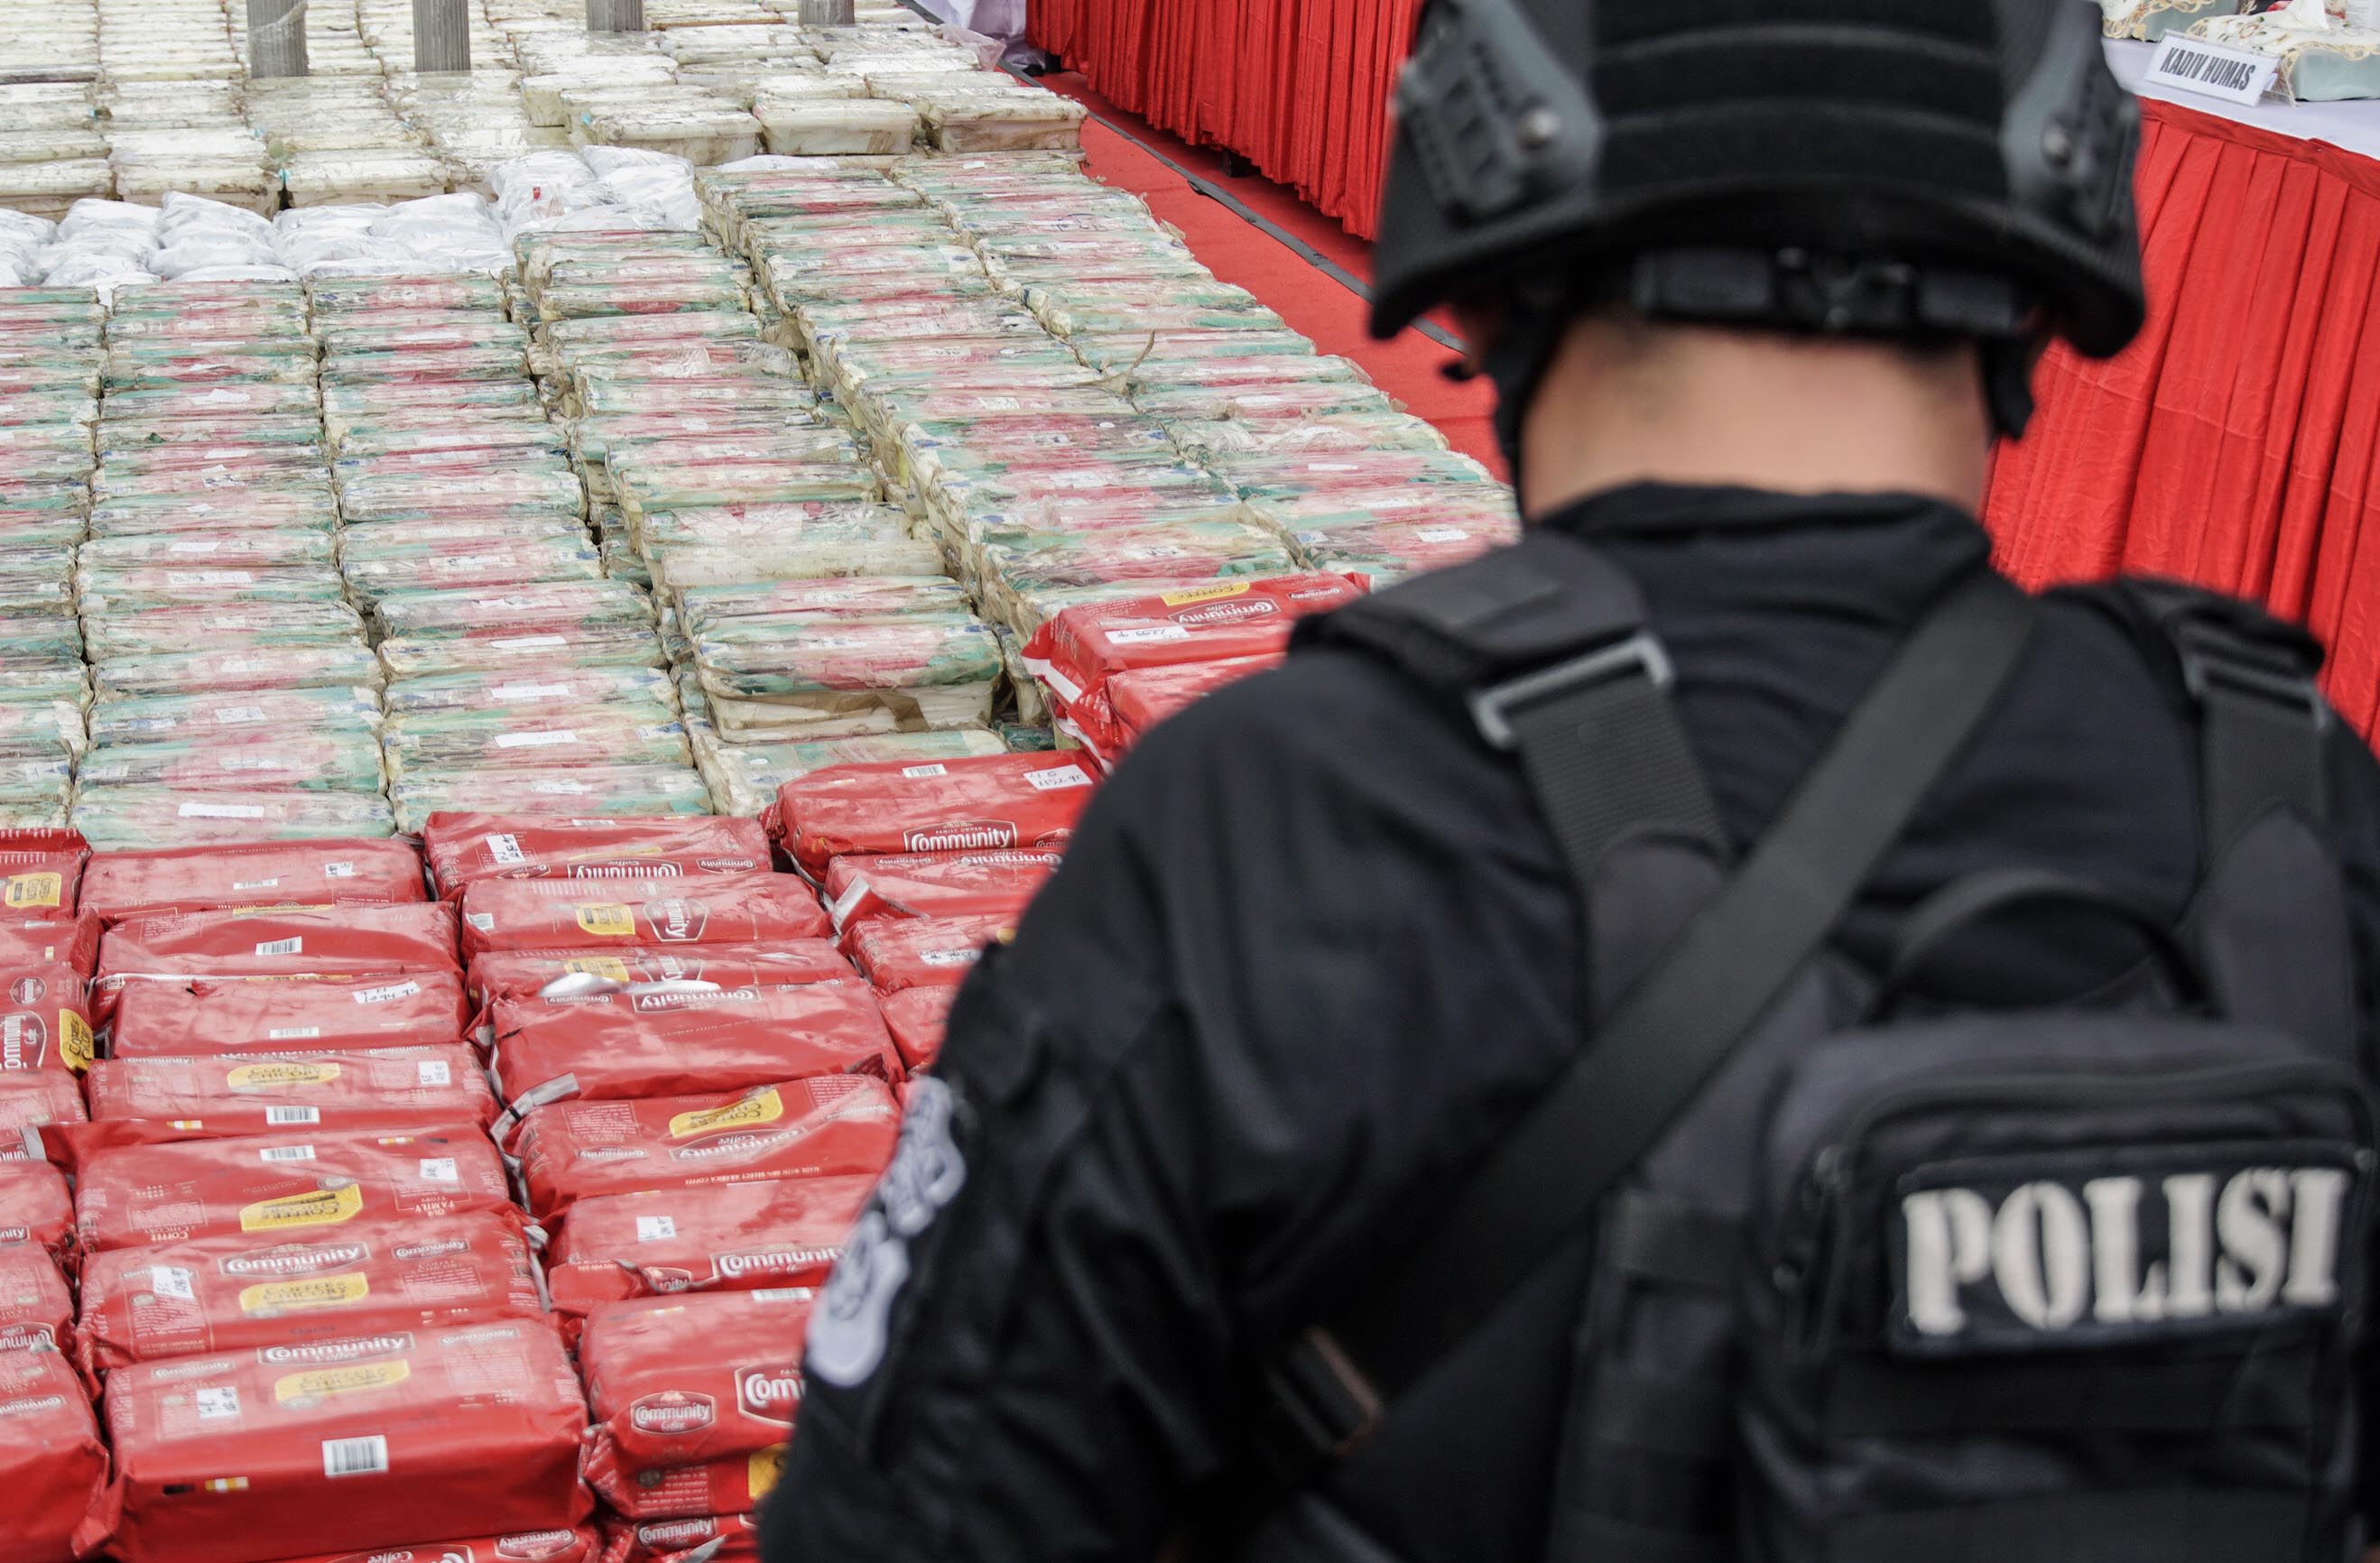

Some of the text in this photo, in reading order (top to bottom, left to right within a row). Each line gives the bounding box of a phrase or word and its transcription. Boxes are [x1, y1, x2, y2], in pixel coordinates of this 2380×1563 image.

[2160, 47, 2256, 91] KADIV HUMAS
[1178, 601, 1273, 624] Community
[1205, 603, 1236, 613] Coffee
[911, 827, 1011, 852] Community
[576, 864, 677, 878] Community
[700, 859, 756, 869] Community
[641, 989, 756, 1008] Community
[718, 1133, 756, 1145] Coffee
[414, 1200, 455, 1214] FAMILY
[227, 1245, 359, 1273] Community
[396, 1241, 466, 1257] Community
[1901, 1167, 2347, 1336] POLISI
[265, 1336, 405, 1360] Community
[634, 1402, 710, 1425] Community
[638, 1519, 713, 1547] Community
